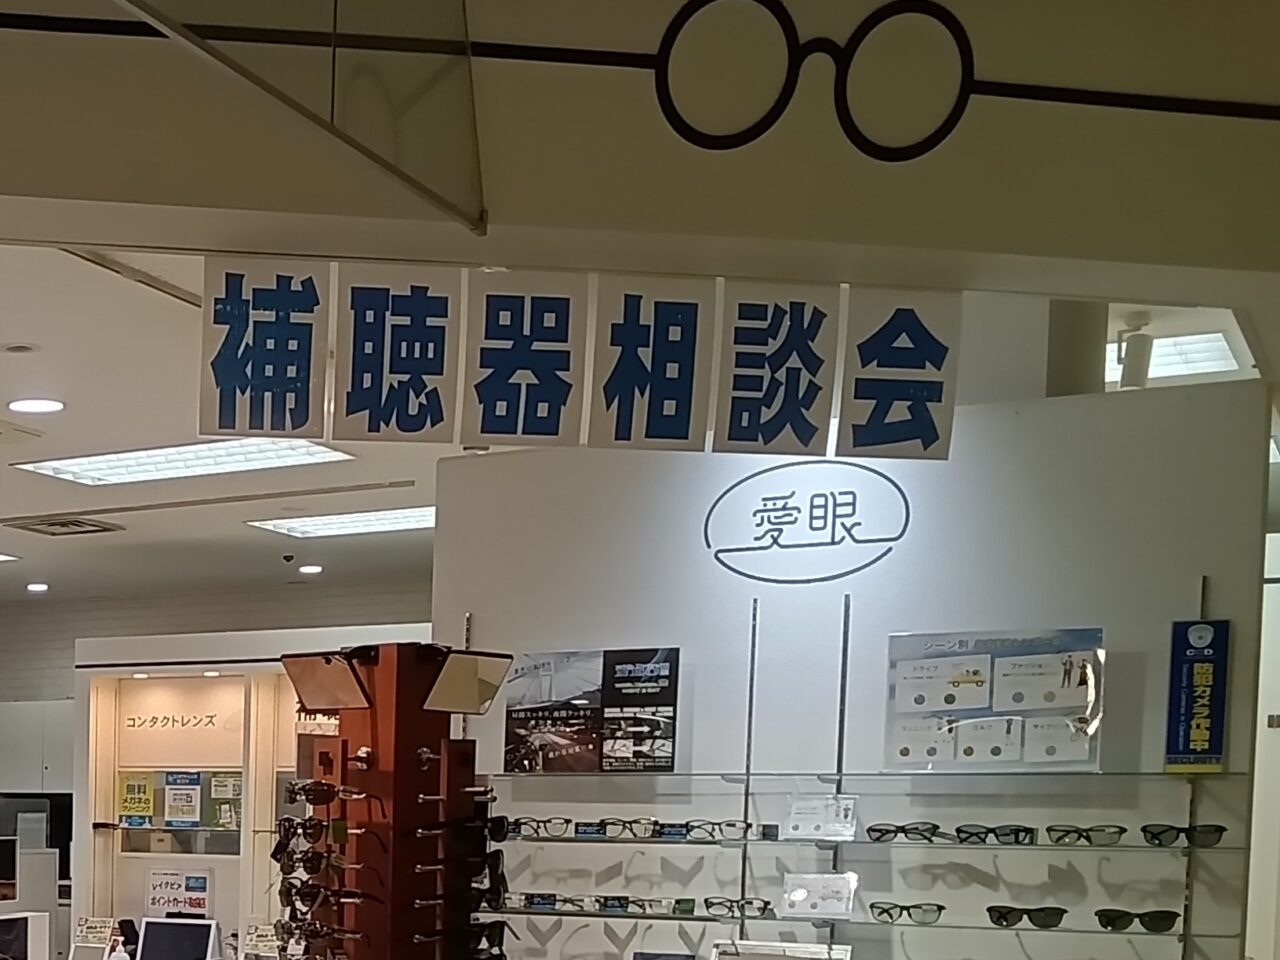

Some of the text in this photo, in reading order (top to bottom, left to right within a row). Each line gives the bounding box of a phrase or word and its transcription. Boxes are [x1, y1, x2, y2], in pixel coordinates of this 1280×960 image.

[210, 271, 952, 452] 補聴器相談会
[753, 491, 861, 549] 愛眼
[1186, 648, 1214, 657] CCD
[1189, 662, 1214, 752] 防犯カメラ作動中
[126, 712, 217, 729] コンタクトレンズ
[126, 784, 147, 796] 無料
[122, 797, 151, 806] メガネの
[122, 805, 151, 813] クリーニング
